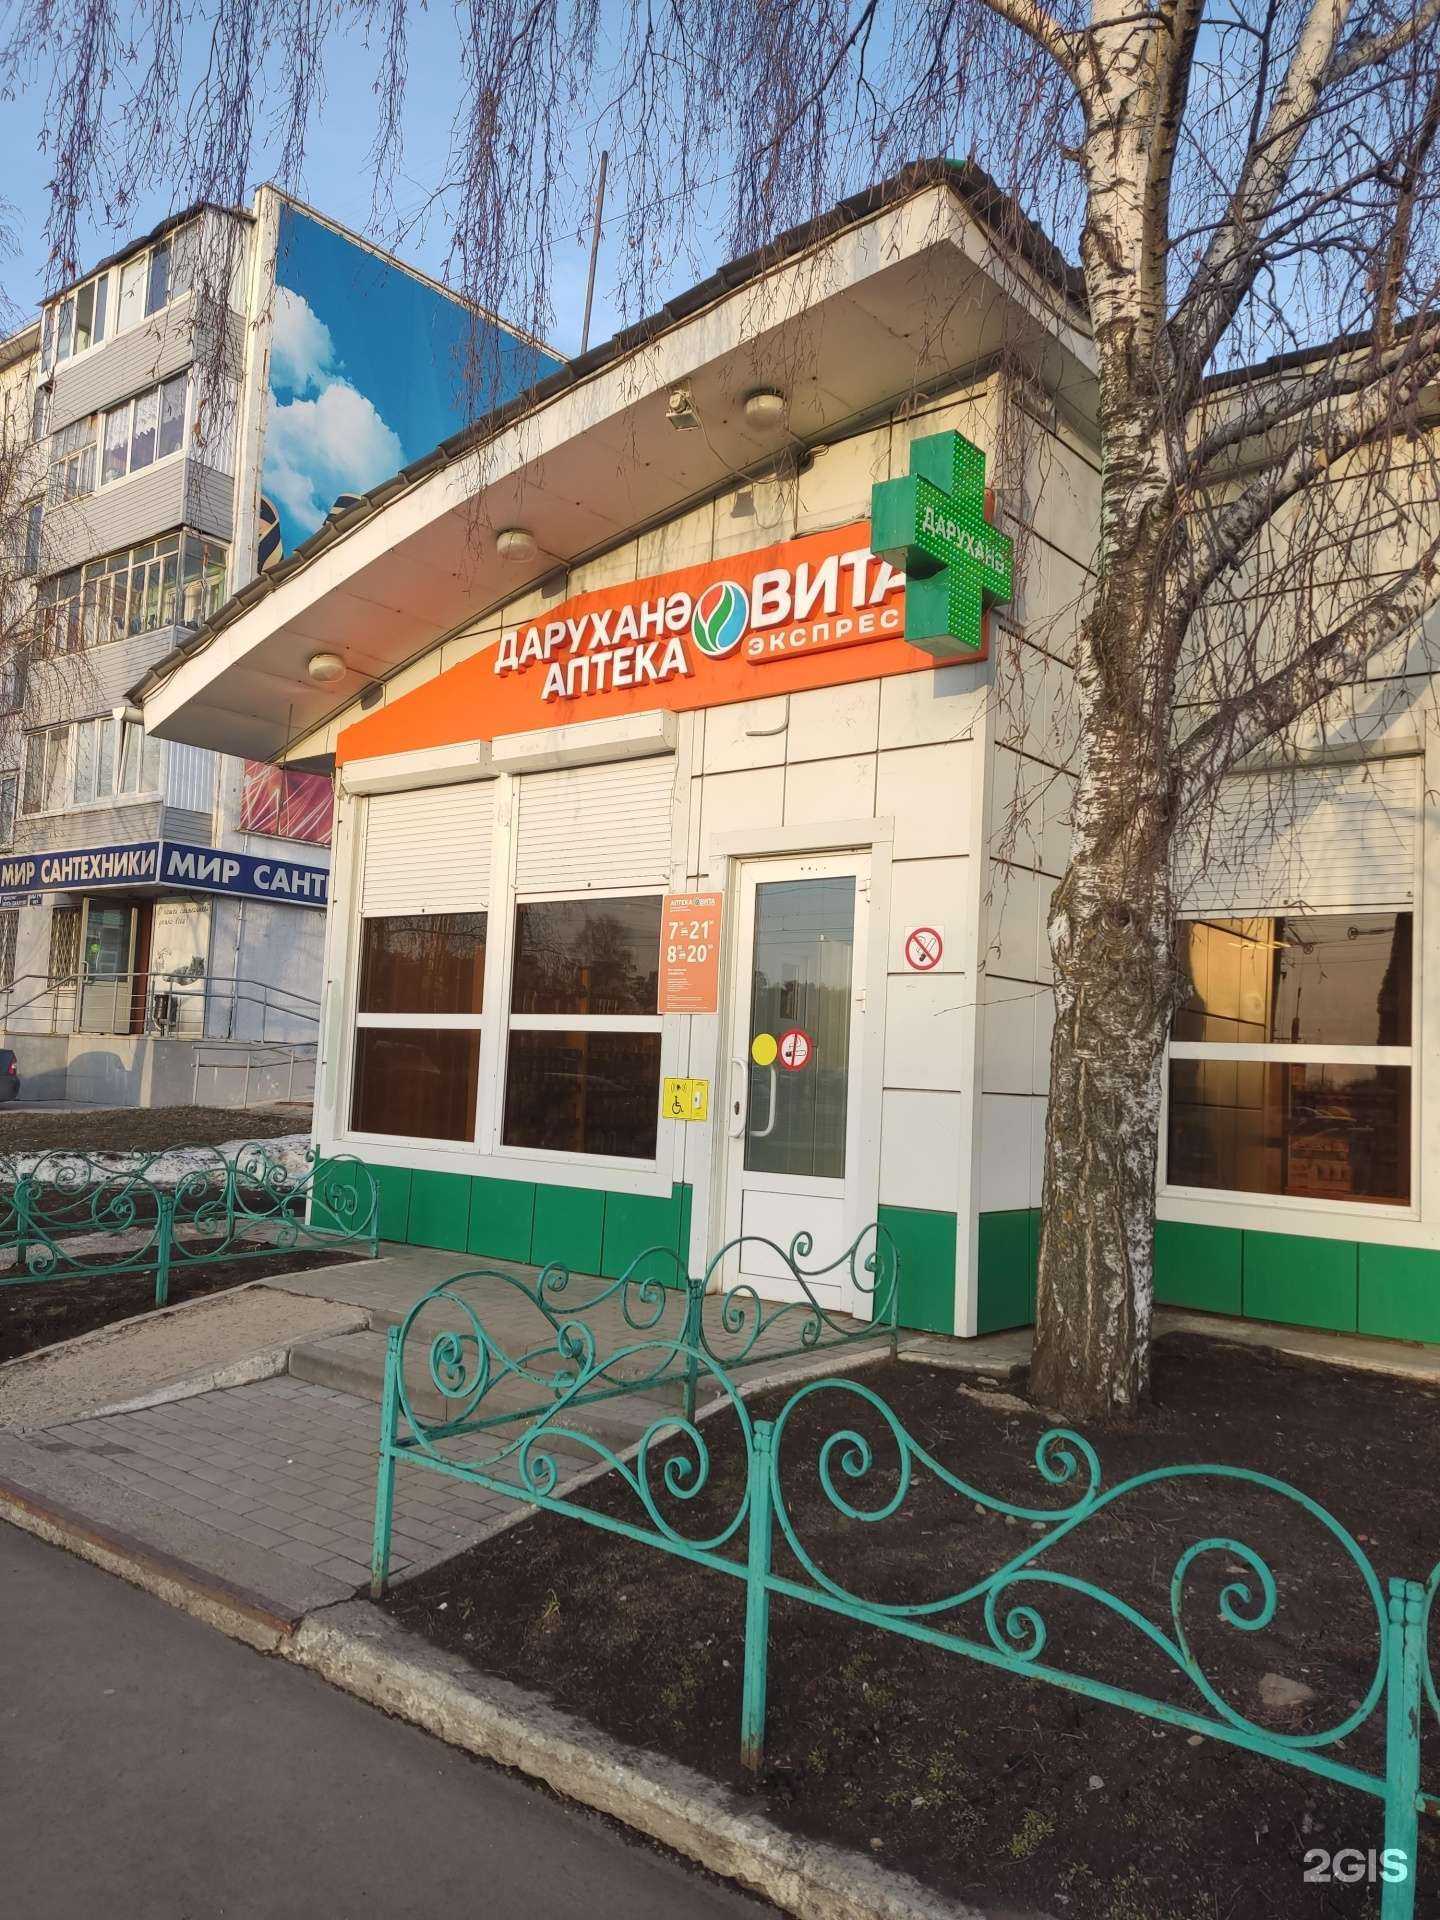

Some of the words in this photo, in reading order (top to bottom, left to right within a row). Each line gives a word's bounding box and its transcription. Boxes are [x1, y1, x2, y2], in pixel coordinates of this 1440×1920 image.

[494, 591, 692, 674] ДАРУХАНӘ
[748, 609, 899, 656] ЭКСПРЕС
[541, 637, 688, 699] АПТЕКА
[1, 861, 35, 887] МИР
[41, 849, 156, 883] САНТЕХНИКИ
[167, 851, 240, 884] МИР
[253, 865, 329, 897] САНТ
